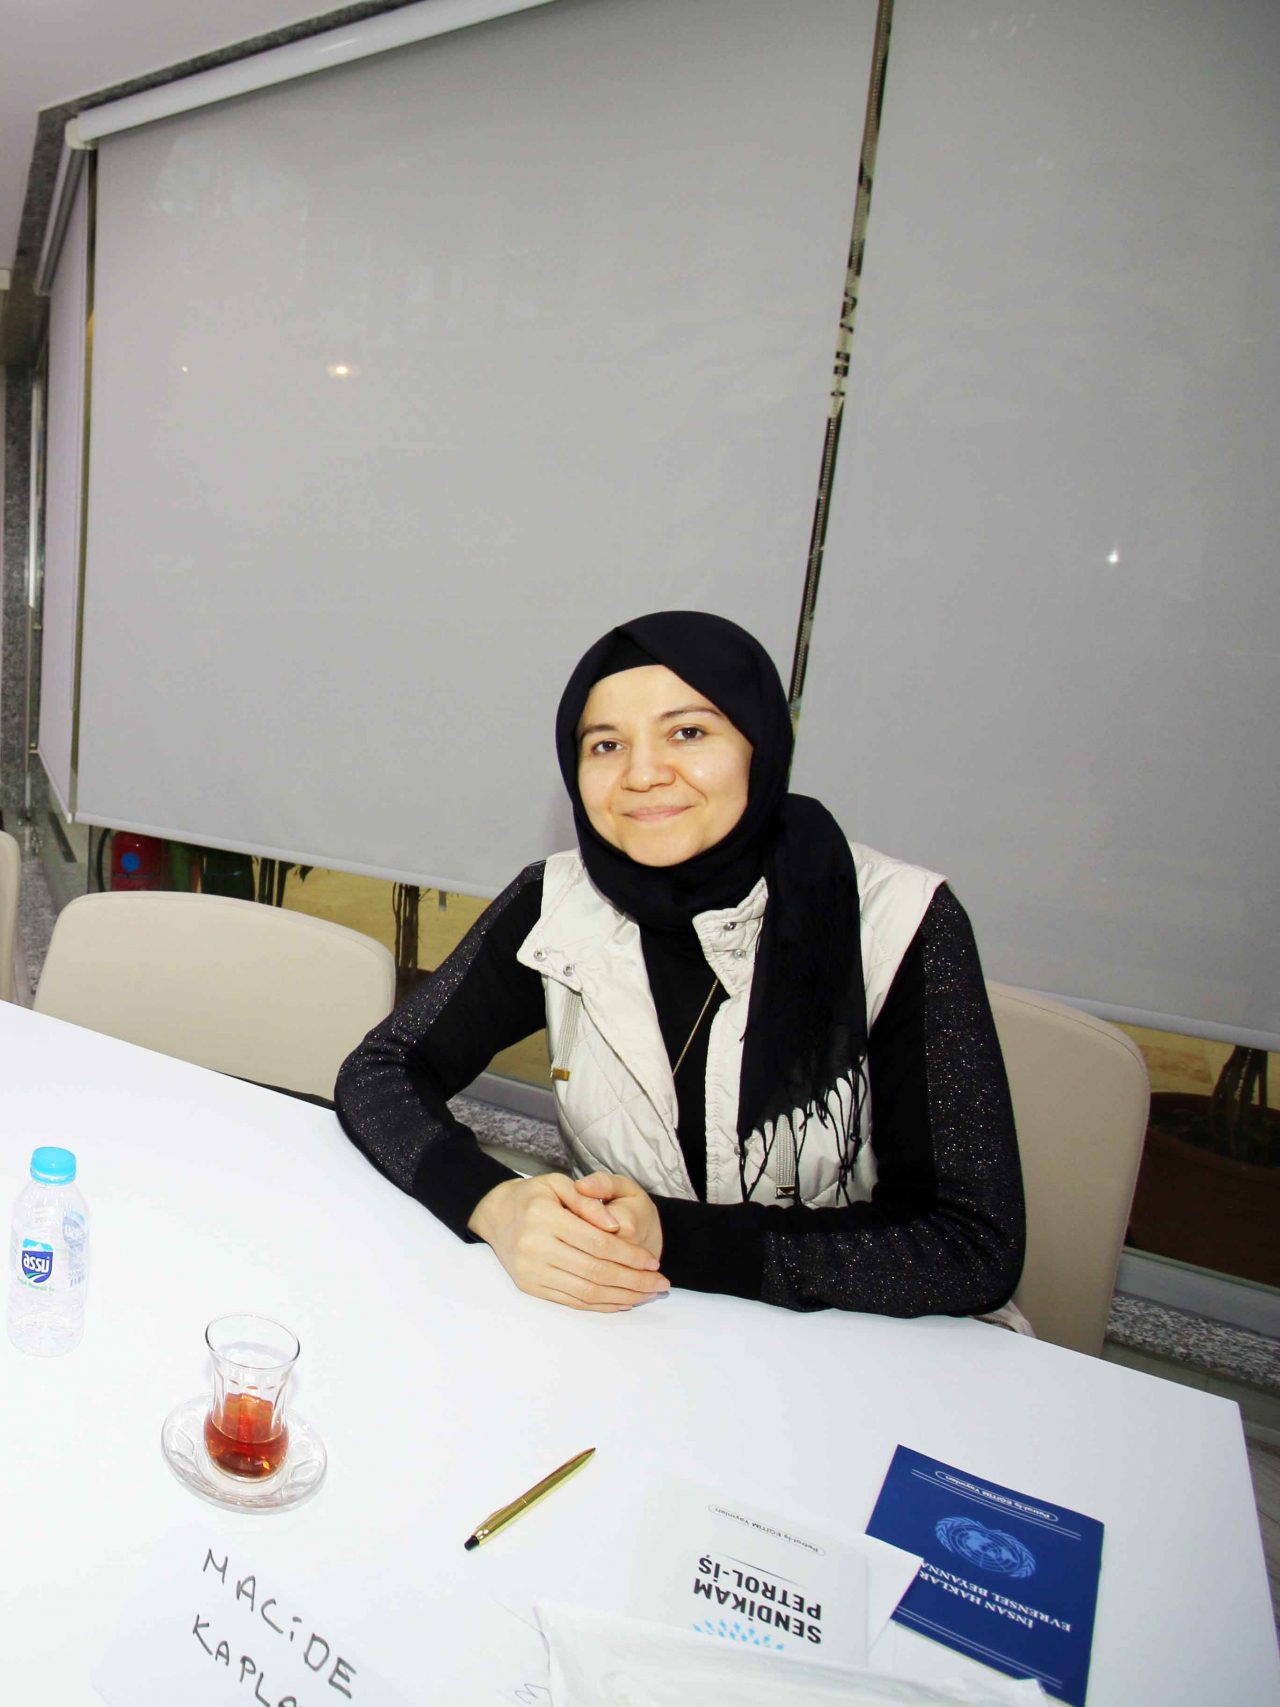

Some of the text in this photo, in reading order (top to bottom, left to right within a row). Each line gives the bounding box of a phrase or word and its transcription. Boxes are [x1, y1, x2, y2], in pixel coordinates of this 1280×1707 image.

[23, 1252, 51, 1274] assu
[697, 1554, 822, 1621] PETROL-İŞ
[693, 1577, 822, 1645] SENDİKAM
[984, 1600, 1035, 1630] İNSAN
[992, 1591, 1072, 1633] EVRENSEL
